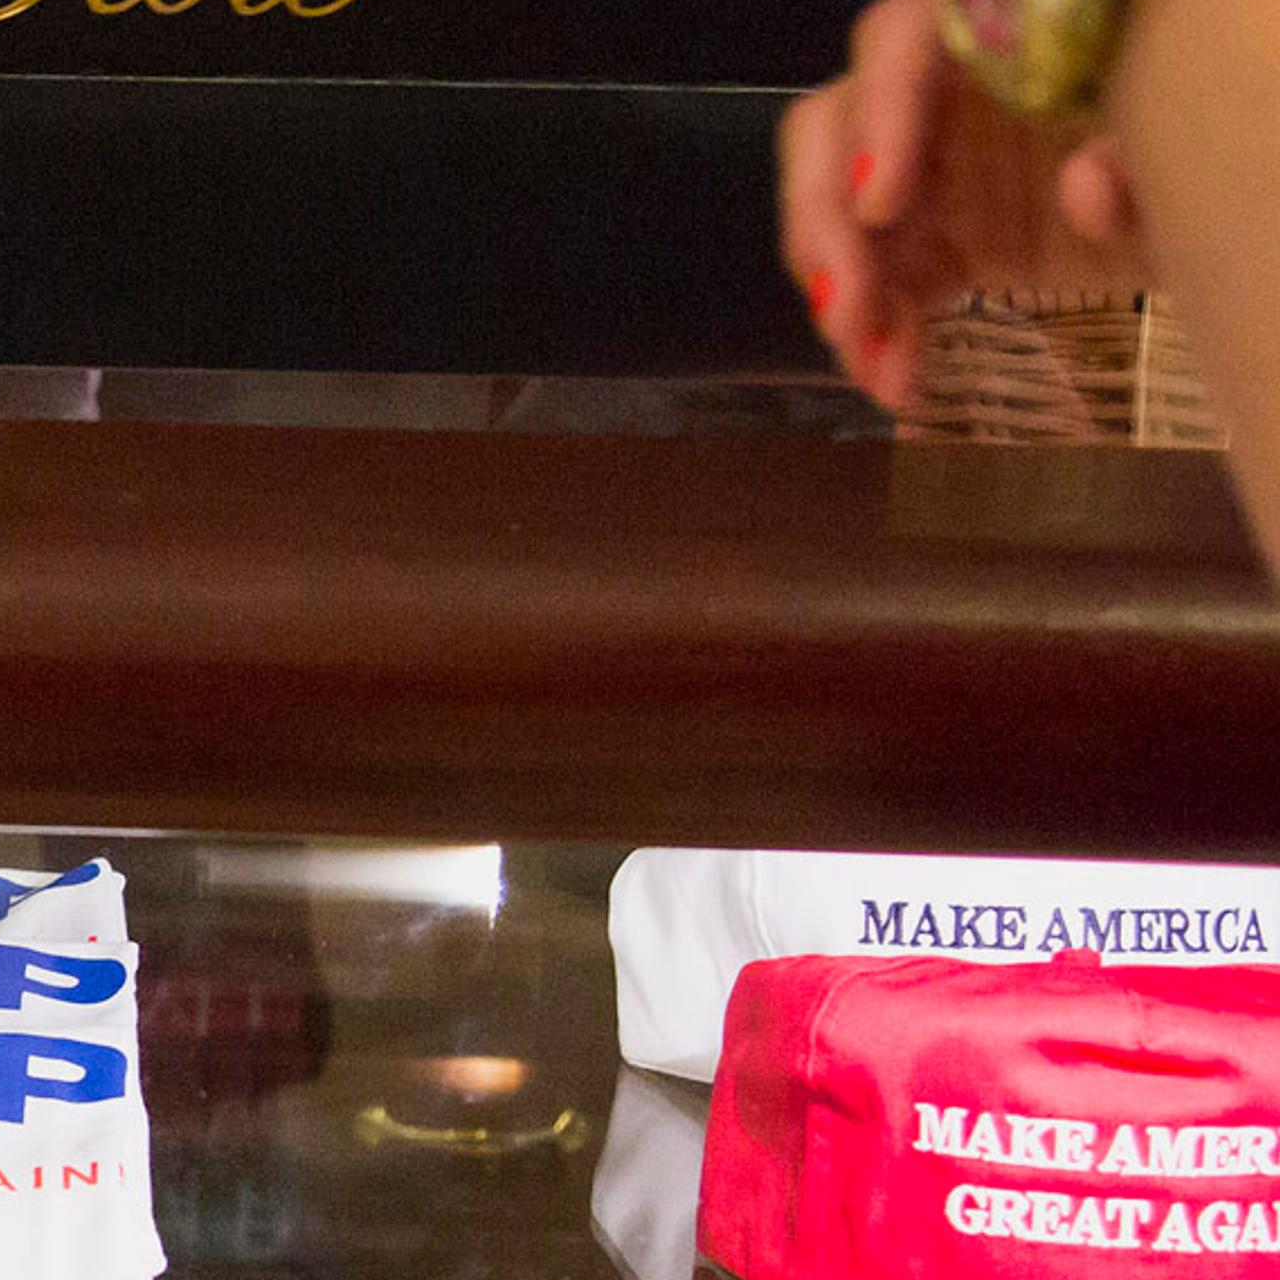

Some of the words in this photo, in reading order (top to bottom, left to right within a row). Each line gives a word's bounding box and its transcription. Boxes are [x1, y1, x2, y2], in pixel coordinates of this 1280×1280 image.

[859, 899, 1027, 951] MAKE
[1037, 907, 1268, 953] AMERICA
[913, 1102, 1097, 1172] MAKE
[1097, 1124, 1280, 1177] AMER
[945, 1184, 1151, 1249] GREAT
